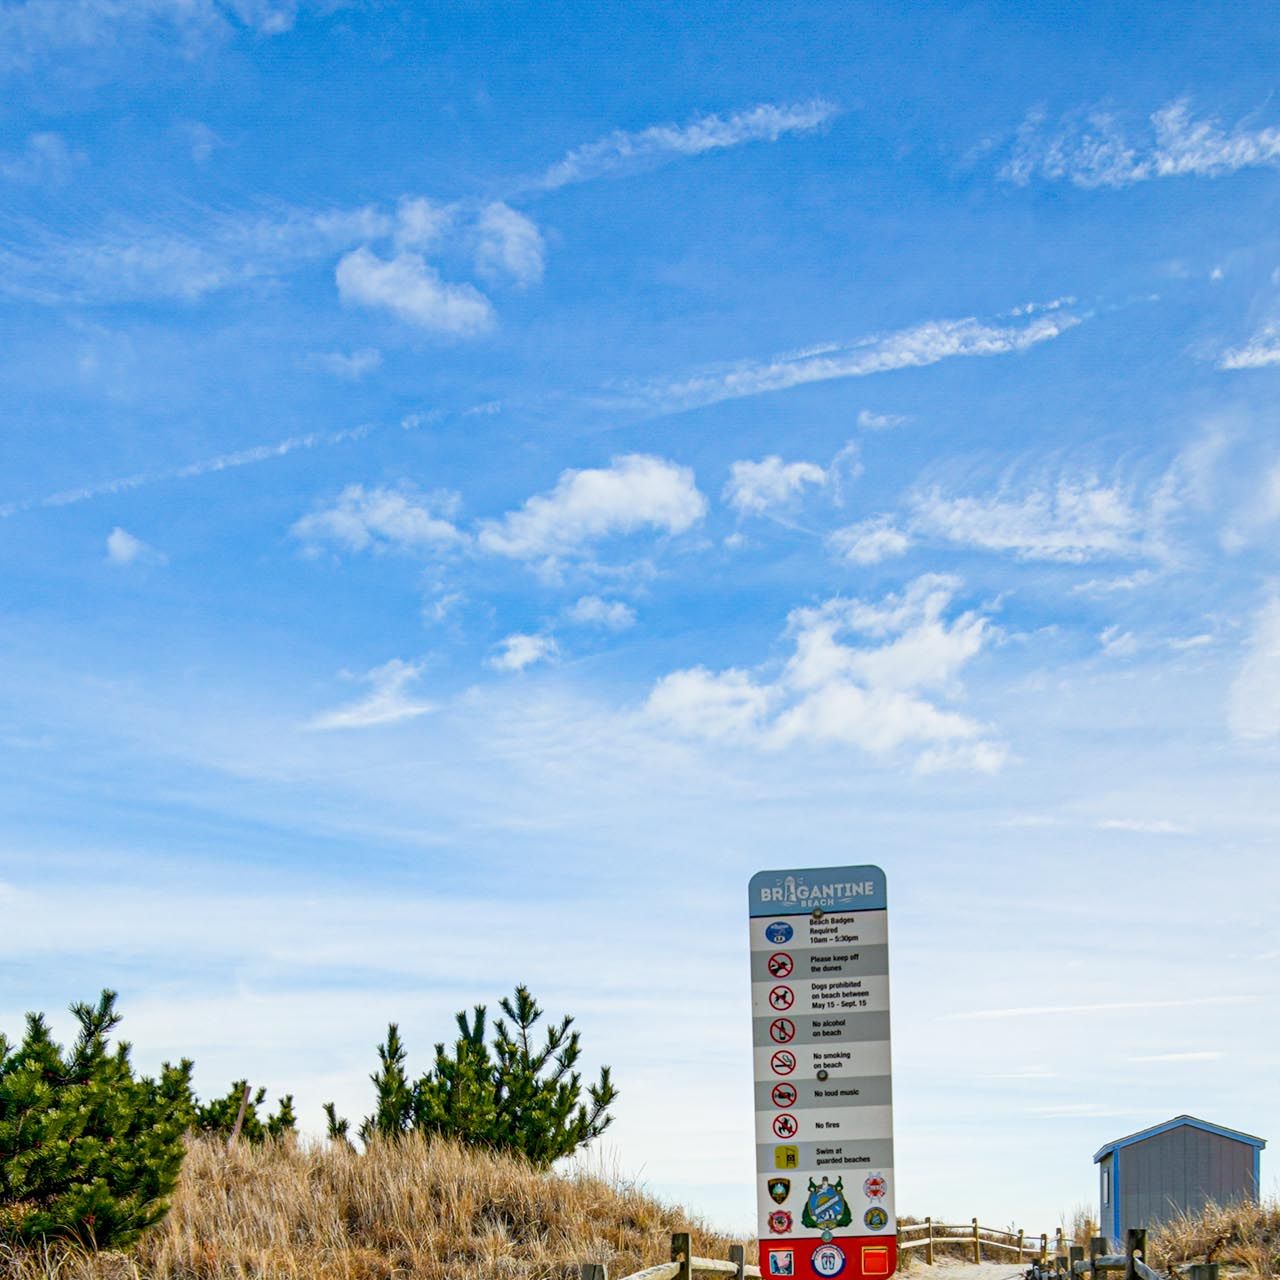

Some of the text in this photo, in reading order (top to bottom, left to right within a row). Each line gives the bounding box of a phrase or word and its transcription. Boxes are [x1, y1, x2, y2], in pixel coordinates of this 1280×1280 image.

[761, 880, 874, 903] BRIGANTINE
[800, 899, 834, 907] BEACH
[831, 917, 854, 925] Badges
[810, 926, 838, 935] Required
[835, 935, 858, 944] 5:30pm
[833, 954, 847, 962] keep
[811, 964, 842, 973] the dunes
[812, 981, 861, 991] Dogs prohibited
[821, 990, 840, 999] beach
[812, 1002, 825, 1010] May
[841, 1000, 857, 1008] Sept.
[812, 1019, 846, 1028] No alcohol
[822, 1028, 841, 1036] beach
[823, 1051, 851, 1060] smoking
[824, 1089, 838, 1097] loud
[840, 1088, 859, 1096] music
[816, 1157, 843, 1166] guarded
